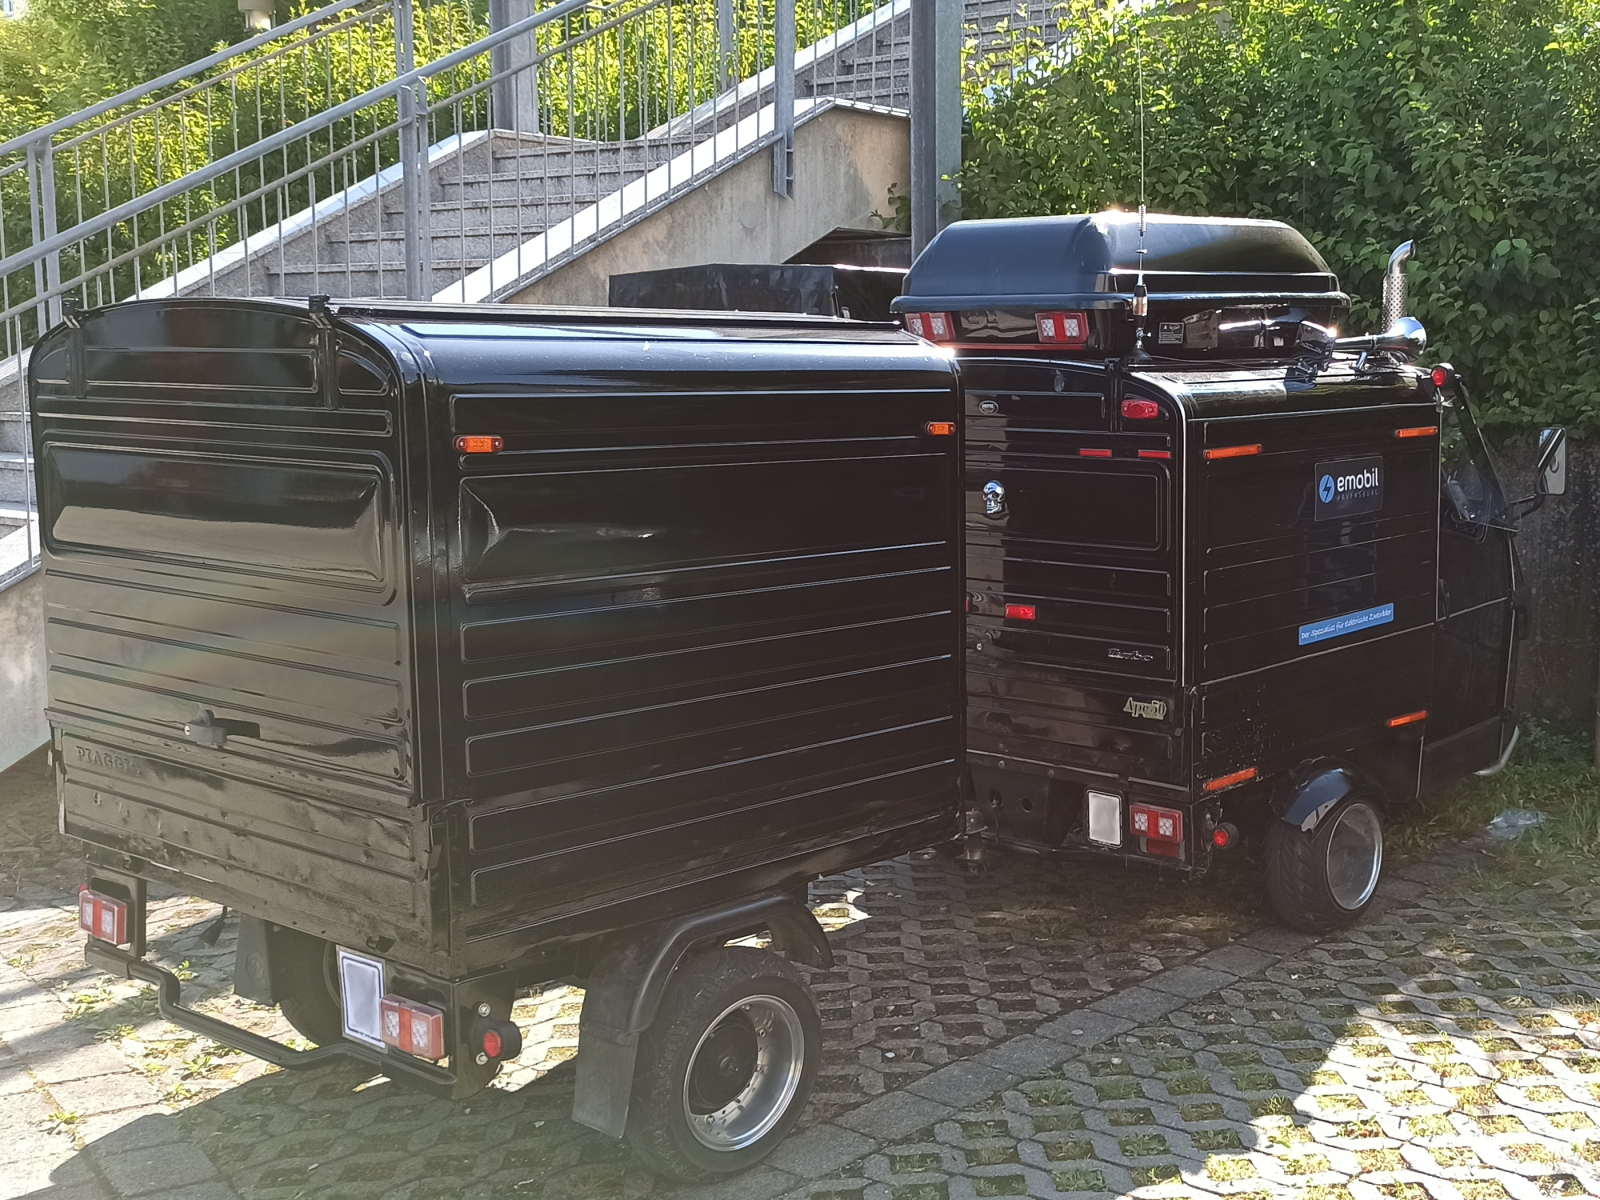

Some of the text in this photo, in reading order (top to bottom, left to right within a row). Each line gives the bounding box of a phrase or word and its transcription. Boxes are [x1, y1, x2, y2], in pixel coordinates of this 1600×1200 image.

[1337, 467, 1379, 492] emobil
[1337, 489, 1379, 501] RAVENSBURG
[1301, 631, 1311, 639] Der
[1310, 625, 1335, 638] Spezialist
[1335, 621, 1344, 633] für
[1107, 647, 1154, 662] Turbo
[75, 745, 143, 777] PIAGGIO
